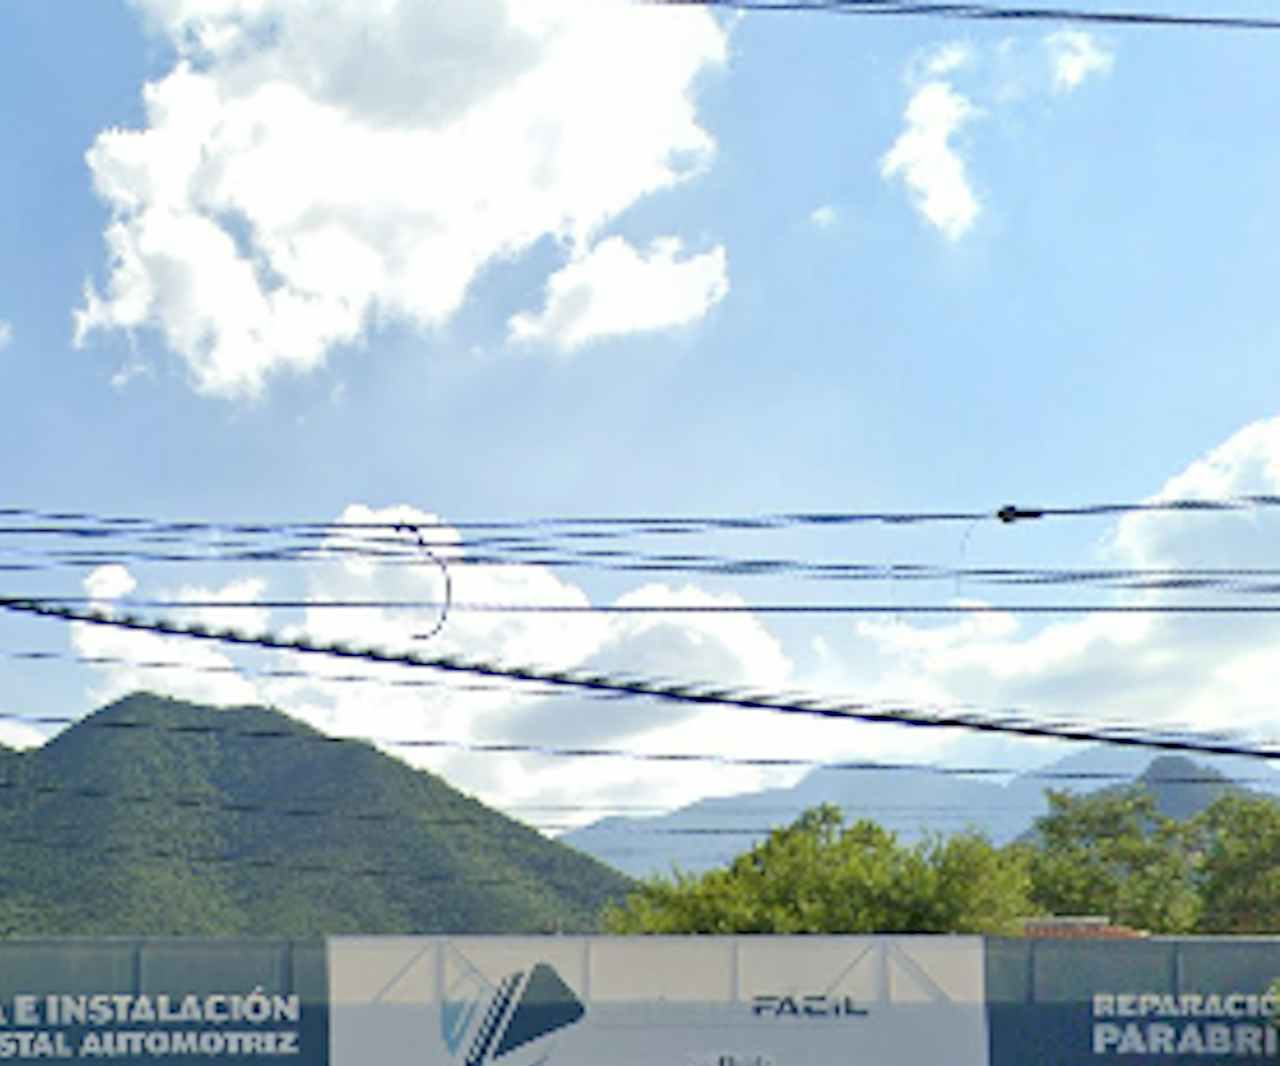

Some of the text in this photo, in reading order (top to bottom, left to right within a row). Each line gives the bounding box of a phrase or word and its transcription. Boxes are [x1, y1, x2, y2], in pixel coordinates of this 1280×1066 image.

[14, 994, 39, 1026] E
[45, 986, 300, 1024] INSTALACIÓN
[79, 1030, 299, 1056] AUTOMOTRIZ
[1092, 1022, 1278, 1056] PARABRI
